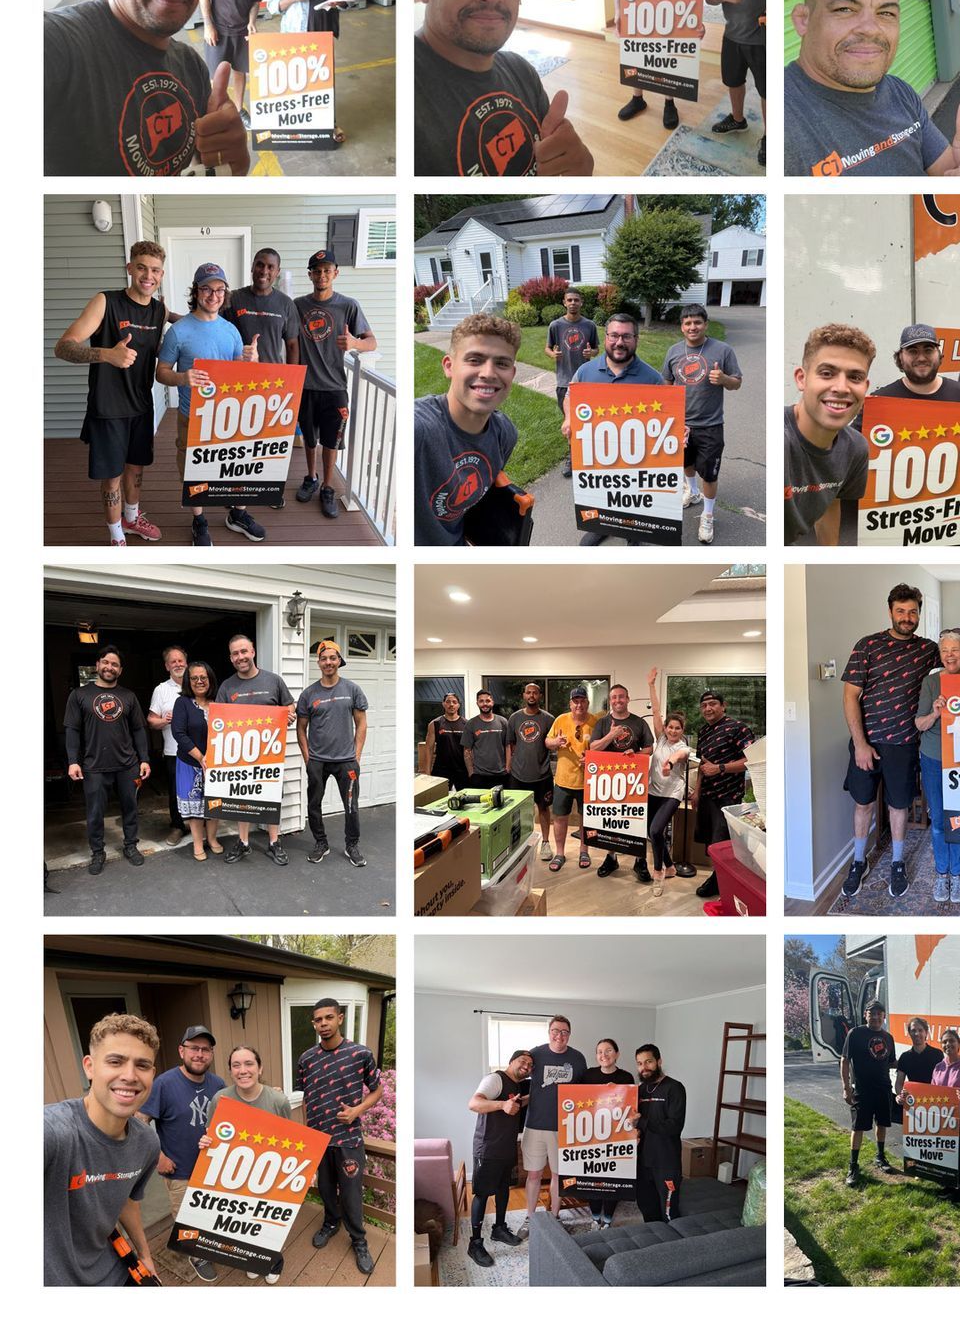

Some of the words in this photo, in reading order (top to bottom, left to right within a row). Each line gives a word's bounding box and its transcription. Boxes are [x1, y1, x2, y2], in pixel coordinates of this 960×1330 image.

[623, 0, 698, 35] 100%
[624, 37, 696, 53] Stress-Free
[644, 55, 677, 68] Move
[254, 53, 329, 96] 100%
[255, 93, 329, 114] Stress-Free
[278, 111, 312, 127] Move
[195, 392, 294, 441] 100%
[575, 417, 679, 465] 100%
[192, 441, 288, 463] Stress-Free
[219, 461, 263, 478] Move
[578, 469, 677, 489] Stress-Free
[607, 491, 652, 508] Move
[903, 522, 956, 546] Move
[211, 728, 282, 764] 100%
[209, 766, 279, 782] Stress-Free
[229, 783, 261, 796] Move
[587, 772, 644, 801] 100%
[586, 803, 644, 816] Stress-Free
[602, 817, 629, 829] Move
[562, 1105, 633, 1143] 100%
[905, 1105, 956, 1133] 100%
[906, 1135, 955, 1148] Stress-Free
[562, 1144, 633, 1161] Stress-Free
[920, 1149, 942, 1160] Move
[203, 1142, 312, 1194] 100%
[583, 1161, 616, 1174] Move
[189, 1189, 293, 1222] Stress-Free
[212, 1214, 262, 1236] Move
